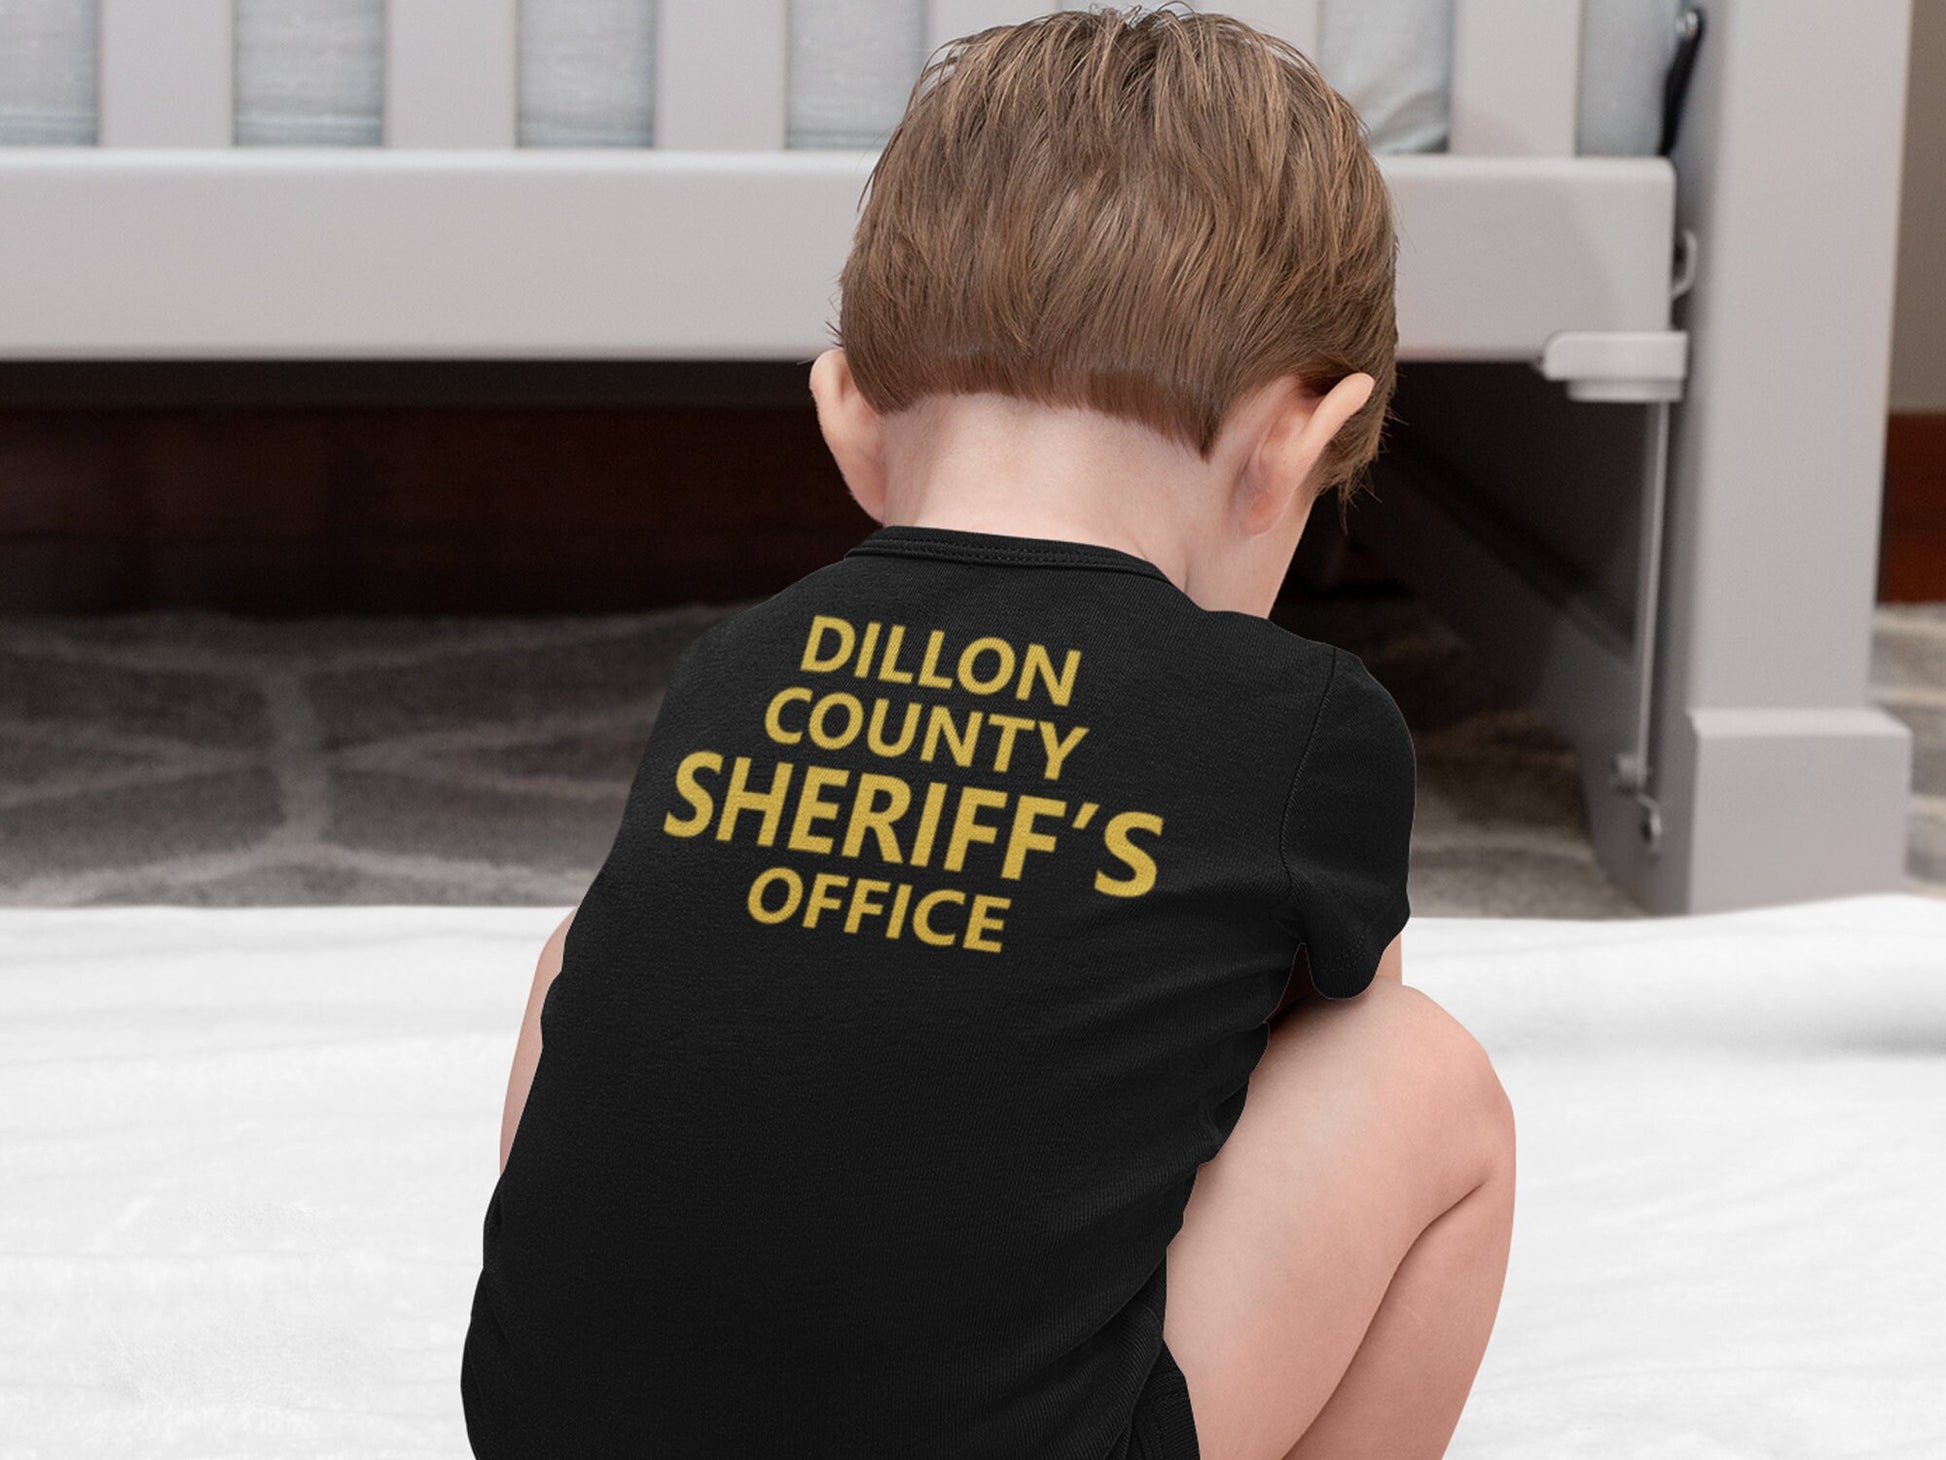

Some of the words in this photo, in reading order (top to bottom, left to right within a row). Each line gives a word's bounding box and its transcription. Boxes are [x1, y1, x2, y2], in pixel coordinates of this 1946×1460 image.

[800, 614, 1081, 707] DILLON
[764, 686, 1089, 780] COUNTY
[663, 750, 1165, 898] SHERIFF'S
[747, 866, 1012, 953] OFFICE
